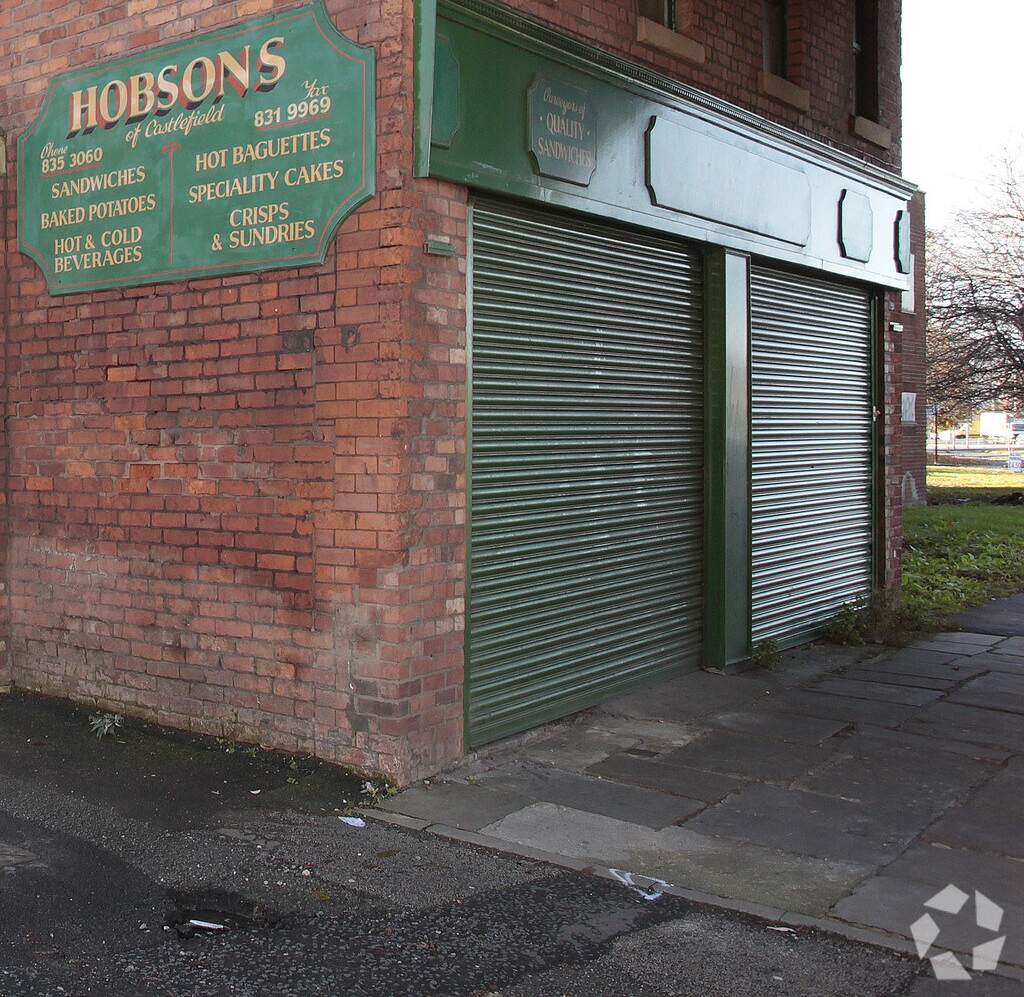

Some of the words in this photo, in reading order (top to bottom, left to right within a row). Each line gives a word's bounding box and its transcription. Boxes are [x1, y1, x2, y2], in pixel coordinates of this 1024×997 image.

[69, 36, 286, 137] HOBSONS
[301, 78, 329, 99] Fax
[126, 127, 142, 148] of
[145, 104, 225, 138] Castlefield
[254, 108, 281, 128] 831
[287, 95, 331, 121] 9969
[546, 112, 585, 140] QUALITY
[40, 142, 68, 159] Phone
[41, 156, 65, 174] 835
[69, 147, 103, 168] 3060
[195, 148, 228, 172] HOT
[232, 128, 331, 165] BAGUETTES
[538, 136, 592, 167] SANDWICHES
[51, 166, 146, 199] SANDWICHES
[188, 171, 280, 204] SPECIALITY
[284, 159, 344, 187] CAKES
[41, 206, 86, 229] BAKED
[88, 193, 156, 221] POTATOES
[229, 202, 290, 227] CRISPS
[54, 235, 82, 255] HOT
[85, 234, 96, 250] &
[101, 225, 143, 248] COLD
[211, 233, 223, 251] &
[229, 219, 315, 249] SUNDRIES
[54, 245, 143, 274] BEVERAGES
